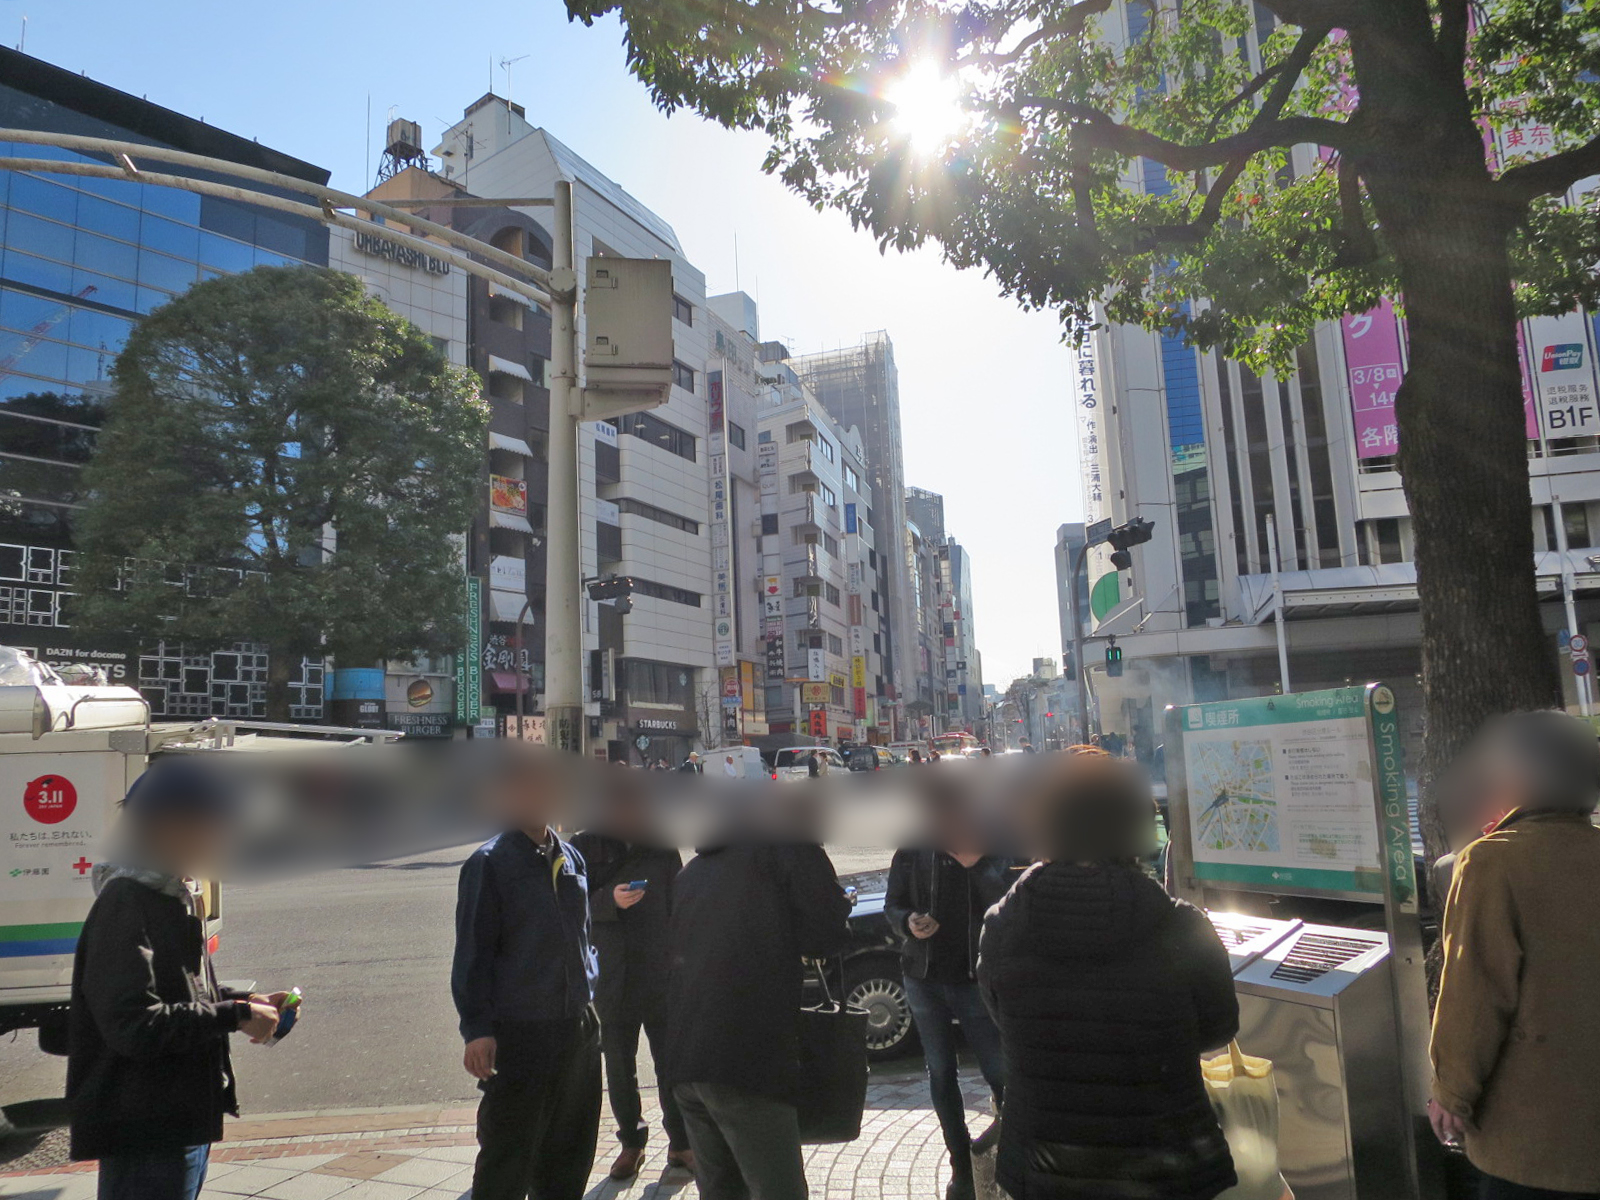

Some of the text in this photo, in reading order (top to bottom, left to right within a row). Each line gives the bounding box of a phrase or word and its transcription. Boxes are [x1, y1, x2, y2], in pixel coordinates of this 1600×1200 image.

[1548, 404, 1594, 429] B1F
[46, 648, 126, 660] DAZN for docomo
[469, 666, 479, 719] BURGER
[1295, 698, 1333, 709] Smoking
[394, 714, 447, 725] FRESHNESS
[1205, 709, 1239, 726] 喫煙所
[401, 726, 440, 734] BURGER
[639, 719, 677, 730] STARBUCKS
[1380, 723, 1407, 881] Smoking Area
